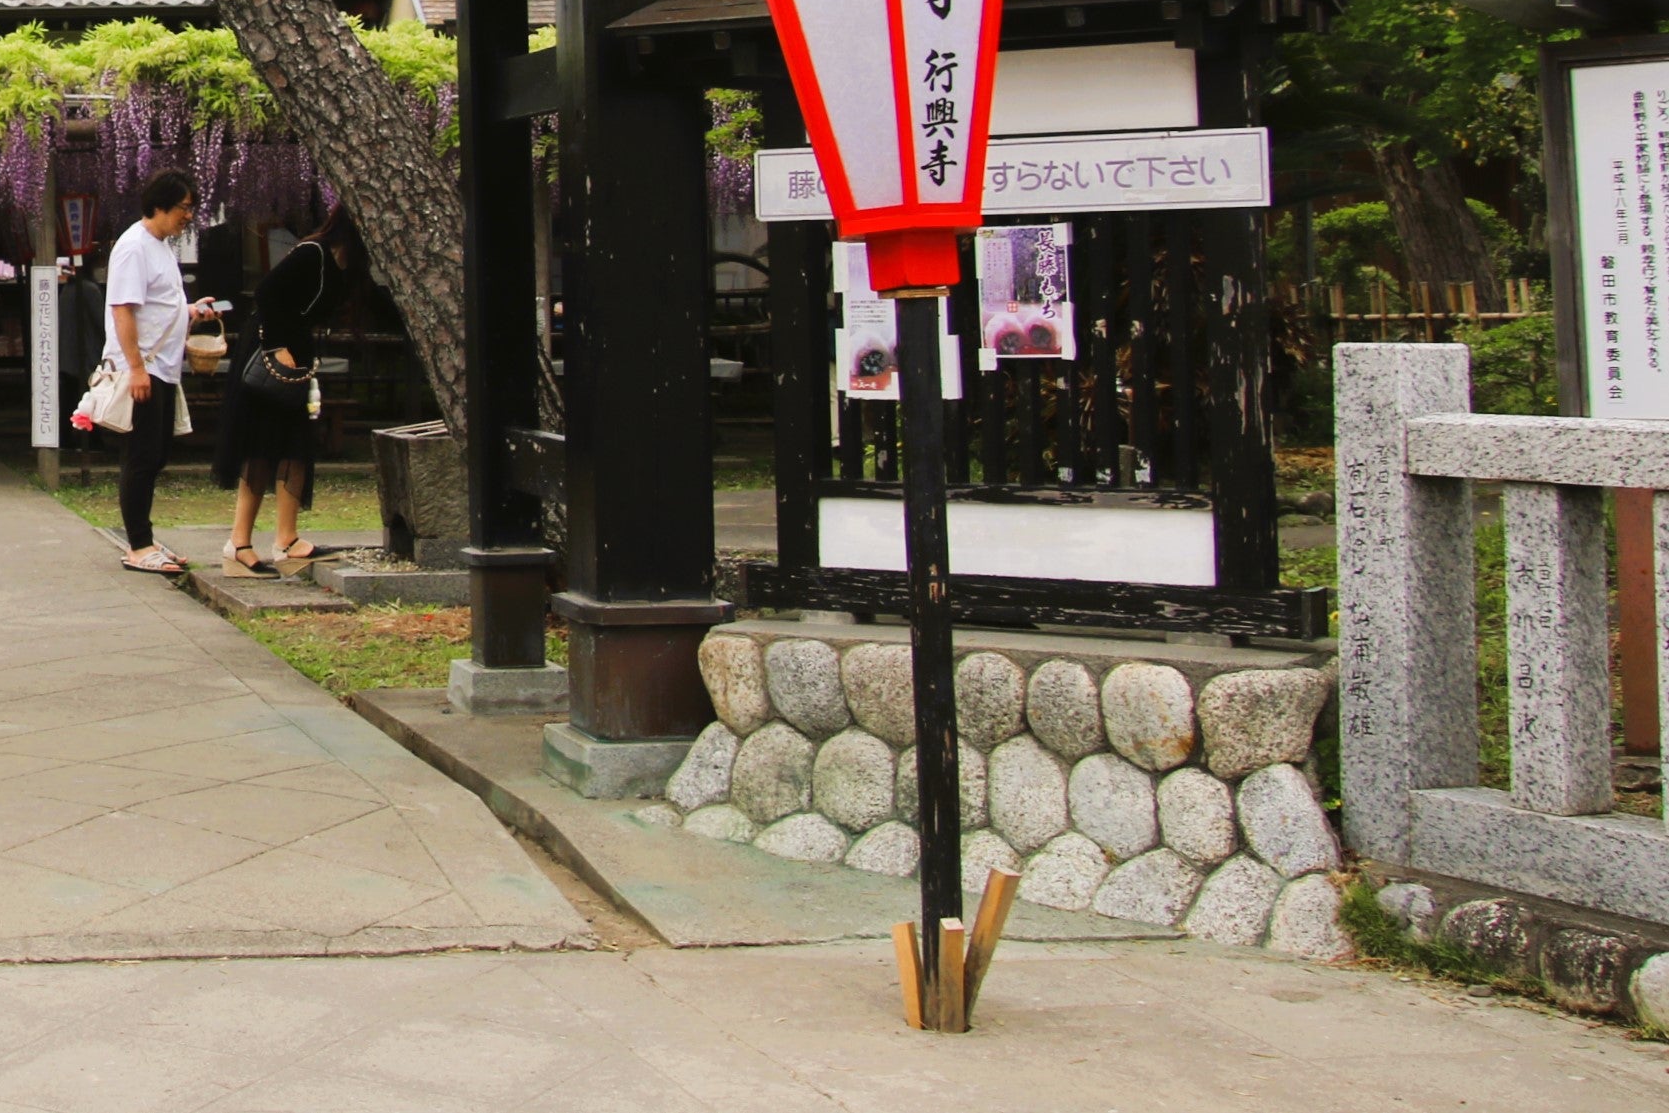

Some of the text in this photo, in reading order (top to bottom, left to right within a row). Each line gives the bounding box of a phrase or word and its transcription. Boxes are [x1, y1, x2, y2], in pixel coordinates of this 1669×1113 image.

[920, 49, 959, 186] 行興寺
[1600, 255, 1623, 400] 磐田市教育委員会
